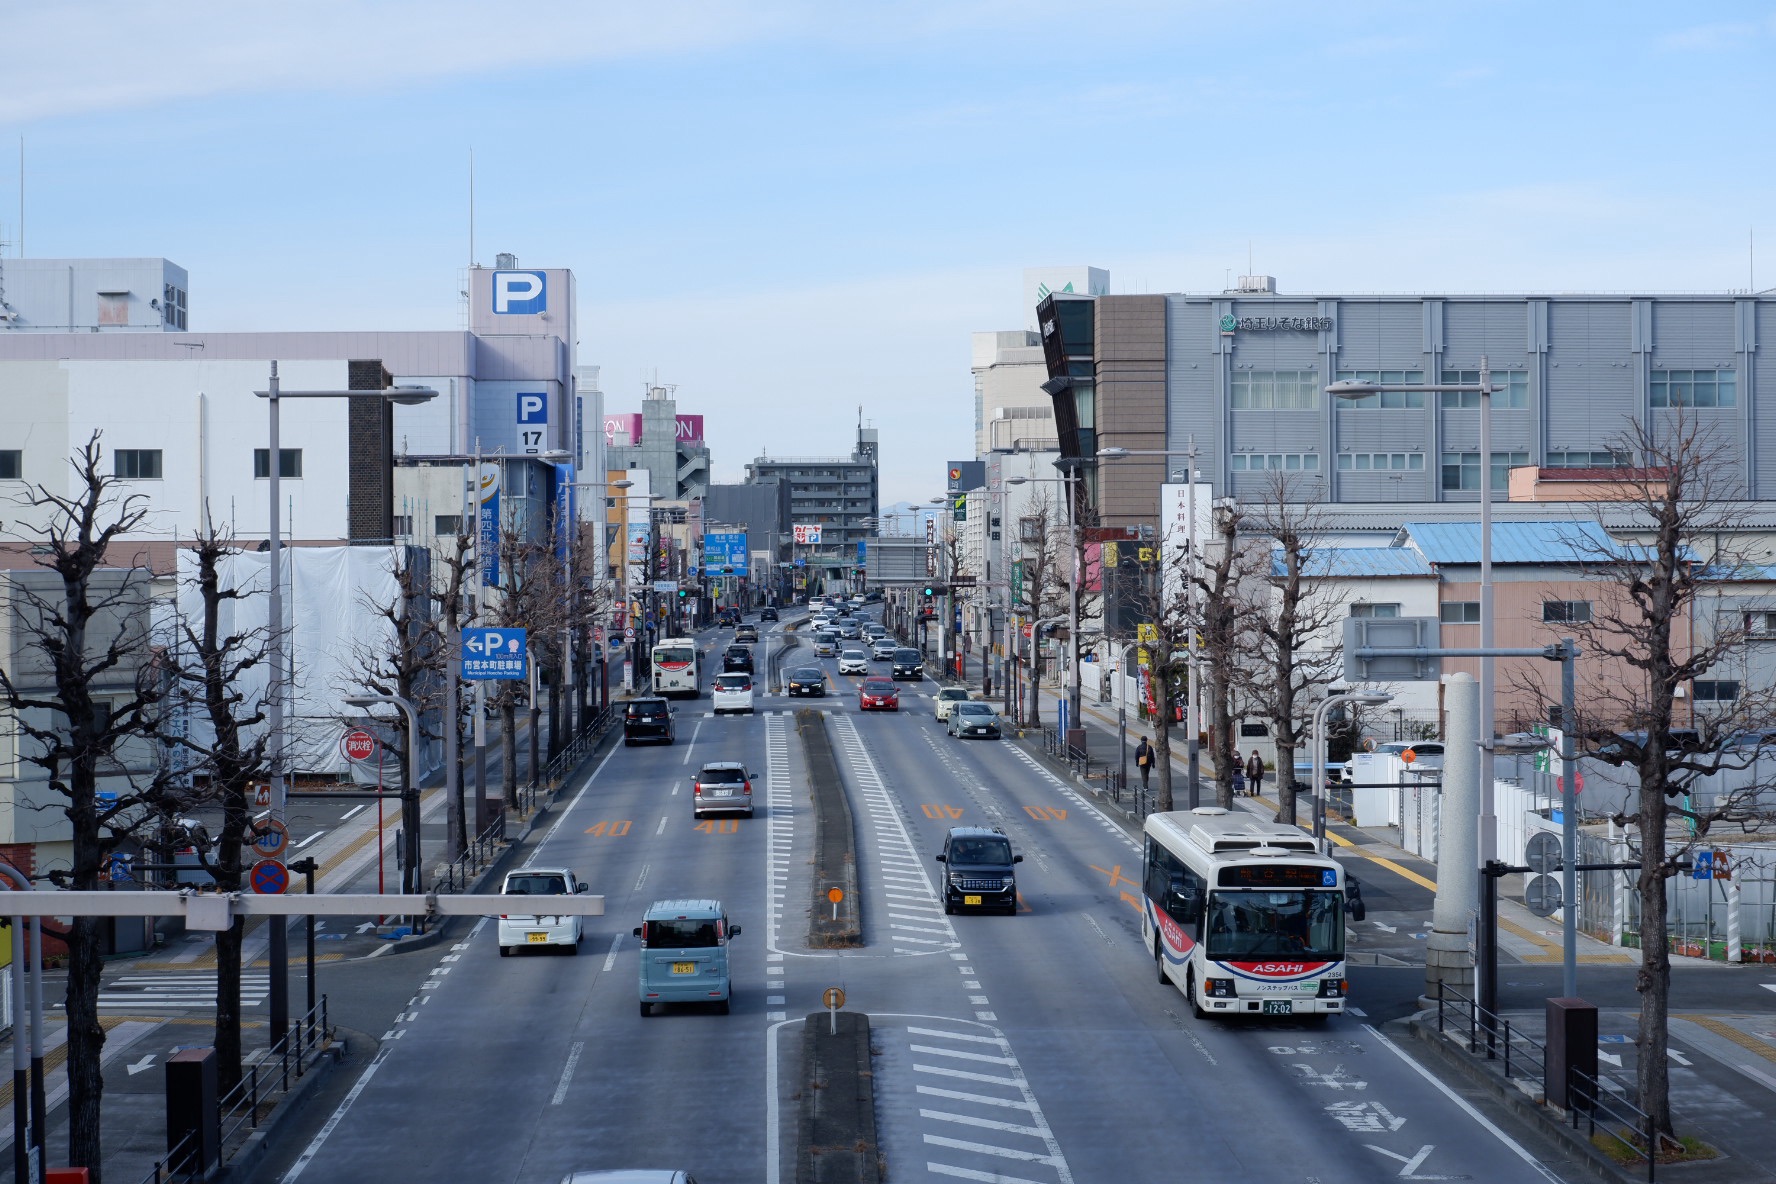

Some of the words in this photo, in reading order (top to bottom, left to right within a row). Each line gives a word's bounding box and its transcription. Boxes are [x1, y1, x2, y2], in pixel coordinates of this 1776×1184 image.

[496, 273, 543, 312] P
[1240, 316, 1333, 331] 埼玉りそな銀行
[521, 396, 543, 420] P
[522, 431, 542, 446] 17
[1177, 489, 1186, 534] 日本料理
[485, 632, 503, 656] P
[464, 660, 522, 670] 市営本町駐車場
[348, 740, 371, 752] 消火栓
[584, 820, 633, 837] 40
[1253, 964, 1304, 973] ASAHI
